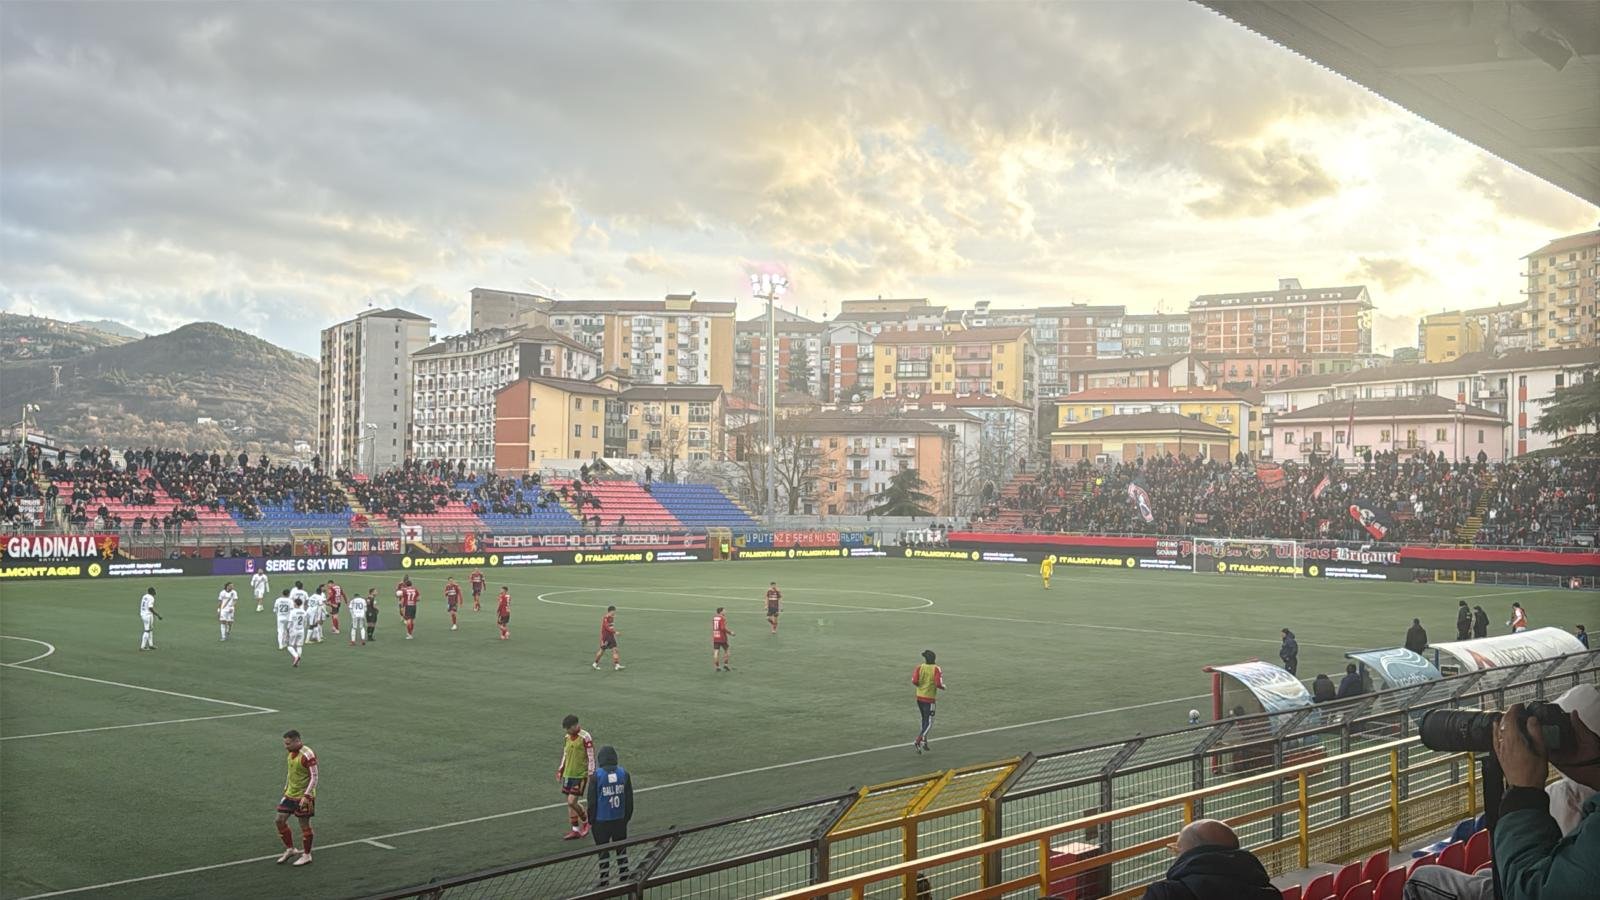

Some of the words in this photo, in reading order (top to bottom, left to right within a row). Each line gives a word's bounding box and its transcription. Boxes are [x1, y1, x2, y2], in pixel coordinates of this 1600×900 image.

[538, 534, 581, 546] VECCHIO
[584, 533, 616, 546] CUORE
[621, 533, 670, 545] ROSSOBLU
[8, 537, 98, 558] GRADINATA
[347, 540, 370, 552] CUORI
[378, 540, 400, 551] LEONE
[584, 553, 643, 562] ITALMONTAGGI
[914, 550, 968, 559] ITALMONTAGGI
[266, 559, 295, 571] SERIE
[297, 559, 305, 571] C
[306, 559, 326, 571] SKY
[327, 559, 348, 570] WIFI
[414, 557, 485, 567] ITALMONTAGGI
[1059, 556, 1122, 566] ITALMONTAGGI
[279, 604, 289, 613] 23
[298, 616, 303, 625] 2
[602, 785, 615, 797] BALL
[609, 796, 620, 808] 10
